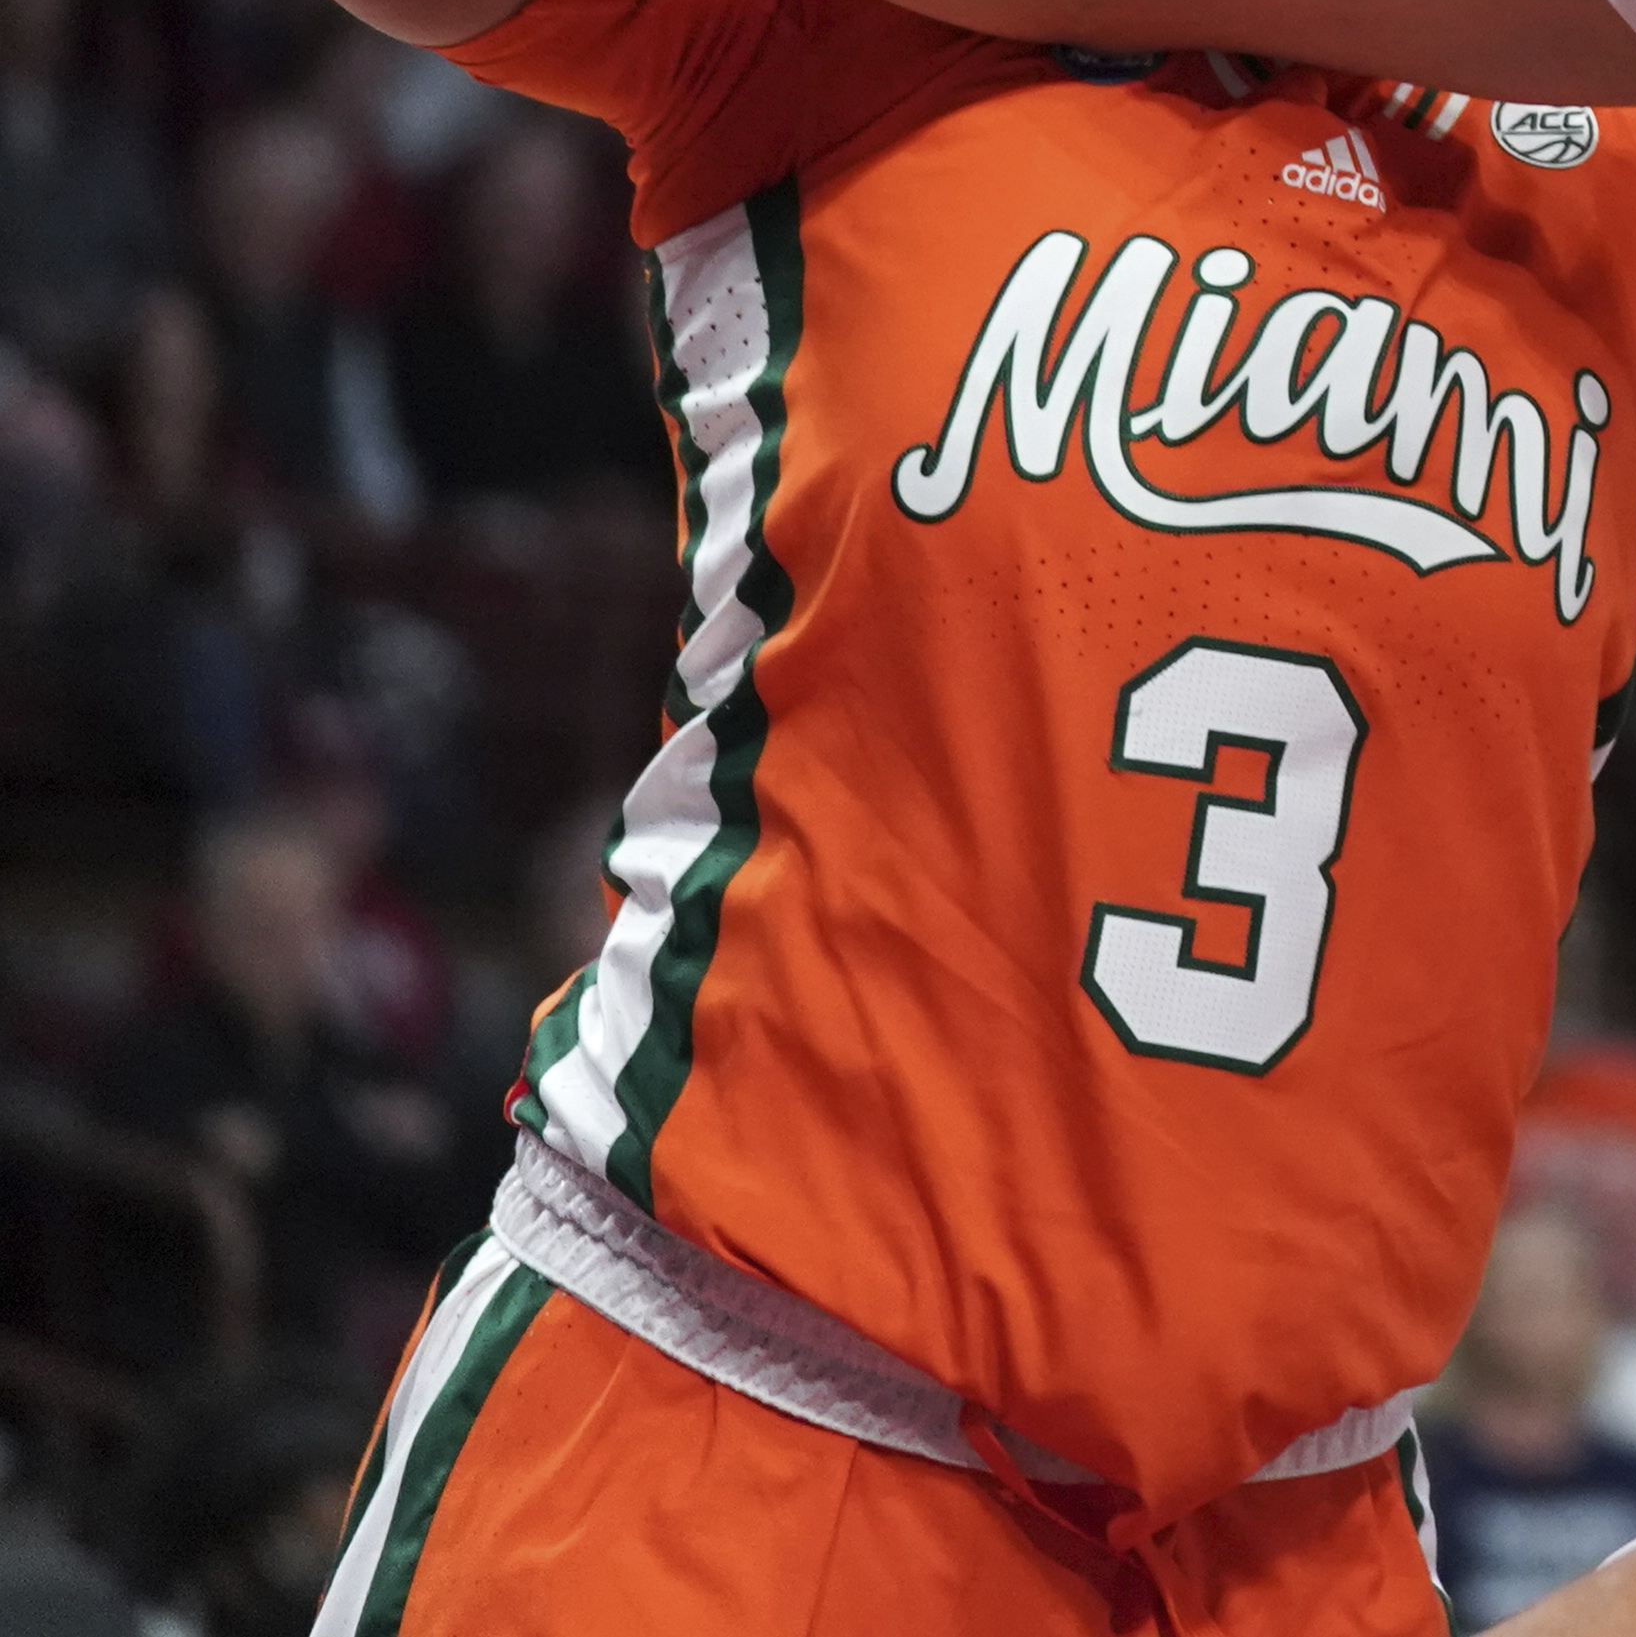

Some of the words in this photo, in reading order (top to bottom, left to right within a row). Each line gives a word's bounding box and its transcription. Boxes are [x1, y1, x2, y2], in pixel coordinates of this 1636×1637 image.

[1508, 110, 1586, 131] ACC
[891, 228, 1611, 626] Miami
[1079, 635, 1370, 1078] 3
